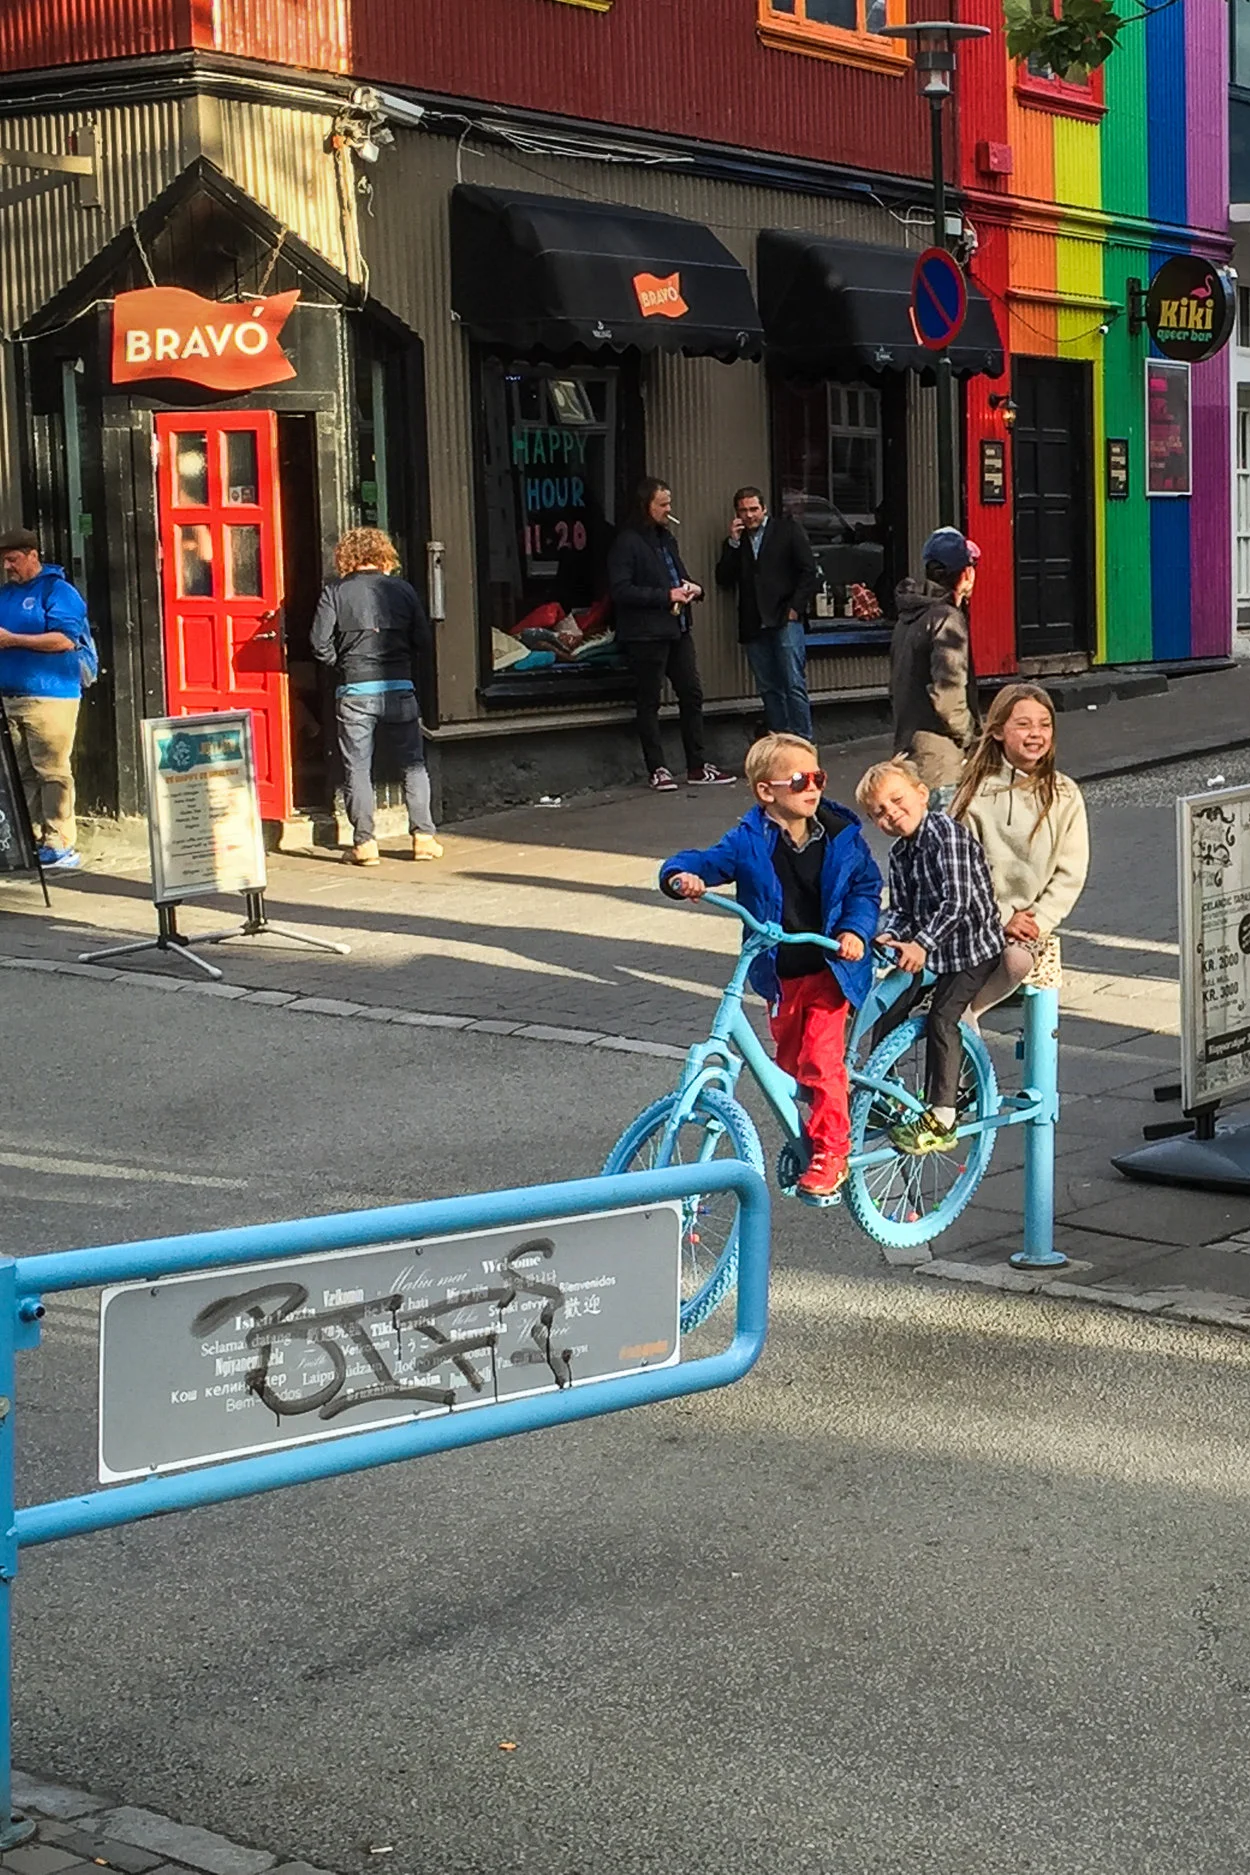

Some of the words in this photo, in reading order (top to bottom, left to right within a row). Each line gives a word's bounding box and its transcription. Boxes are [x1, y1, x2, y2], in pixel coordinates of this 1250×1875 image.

[640, 280, 679, 307] BRAVÓ
[1158, 297, 1214, 329] Kiki
[126, 306, 269, 362] BRAVÓ
[1157, 330, 1189, 342] queer
[1191, 330, 1213, 342] bar
[512, 429, 588, 465] HAPPY
[526, 476, 586, 511] HOUR
[482, 1256, 541, 1275] Welcome
